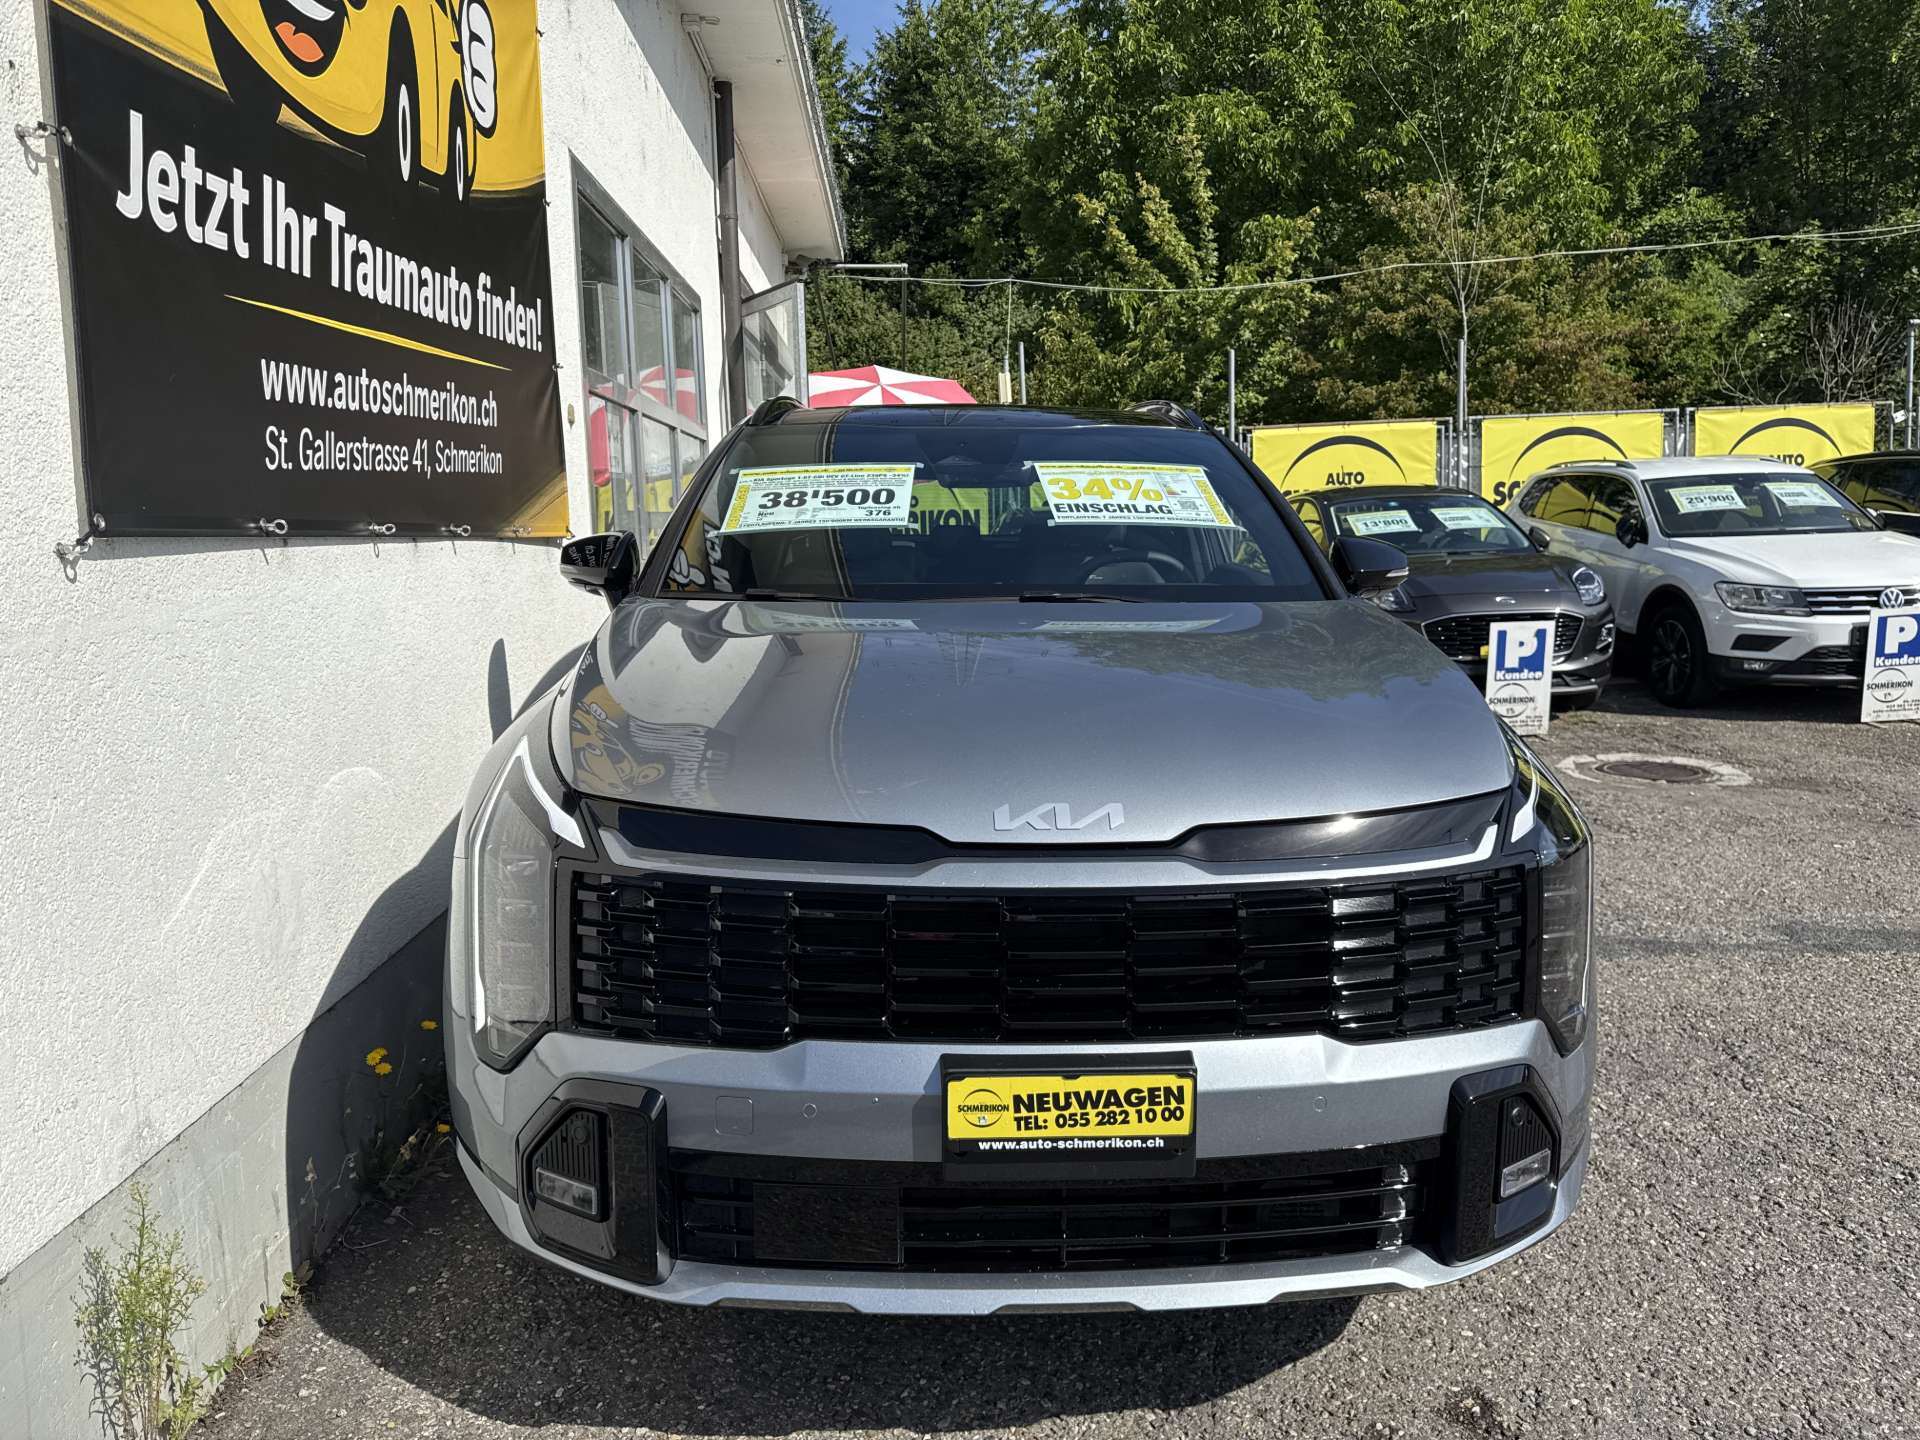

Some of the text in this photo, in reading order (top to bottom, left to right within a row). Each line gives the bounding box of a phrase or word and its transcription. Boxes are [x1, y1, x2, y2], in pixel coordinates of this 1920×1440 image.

[115, 109, 543, 352] Jetzt Ihr Traumauto finden!
[261, 358, 498, 427] www.autoschmerikon.ch
[265, 425, 503, 479] St. Gallerstrasse 41, Schmerikon
[1769, 453, 1805, 466] UTO
[1325, 471, 1365, 486] AUTO
[1048, 478, 1164, 501] 34%
[758, 488, 896, 510] 38'500
[1054, 503, 1174, 515] EINSCHLAG
[1495, 668, 1544, 681] Kunden
[1866, 680, 1914, 691] SCHMERIKON
[957, 1103, 1010, 1113] SCHMERIKON
[1012, 1085, 1185, 1114] NEUWAGEN
[1014, 1106, 1185, 1132] TEL: 055 282 10 00
[978, 1137, 1165, 1151] www.auto-schmerikon.ch
